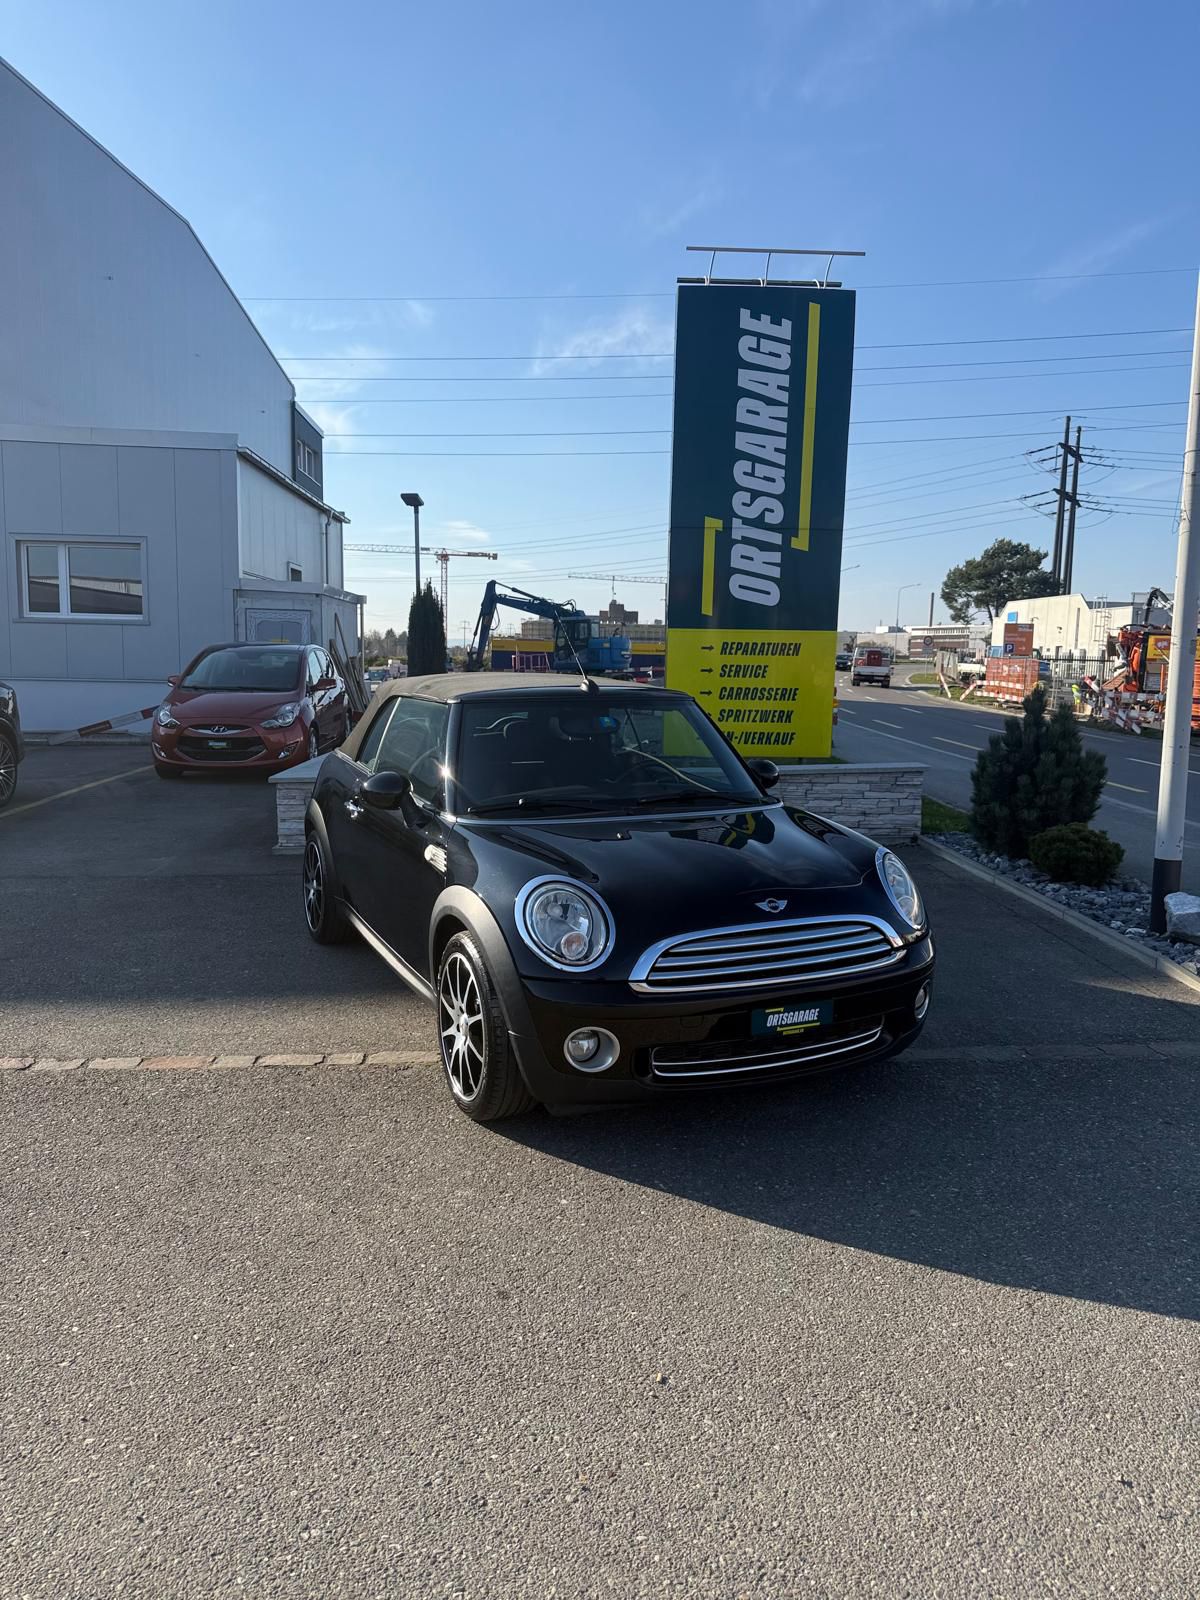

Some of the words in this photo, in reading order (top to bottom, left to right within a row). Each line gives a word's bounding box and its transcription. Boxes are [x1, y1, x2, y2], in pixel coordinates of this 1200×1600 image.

[728, 307, 792, 607] ORTSGARAGE
[720, 641, 801, 656] REPARATUREN
[719, 664, 768, 678] SERVICE
[718, 686, 799, 701] CARROSSERIE
[717, 708, 794, 723] SPRITZWERK
[724, 731, 796, 745] N-/VERKAUF
[766, 1008, 820, 1027] ORTSGARAGE
